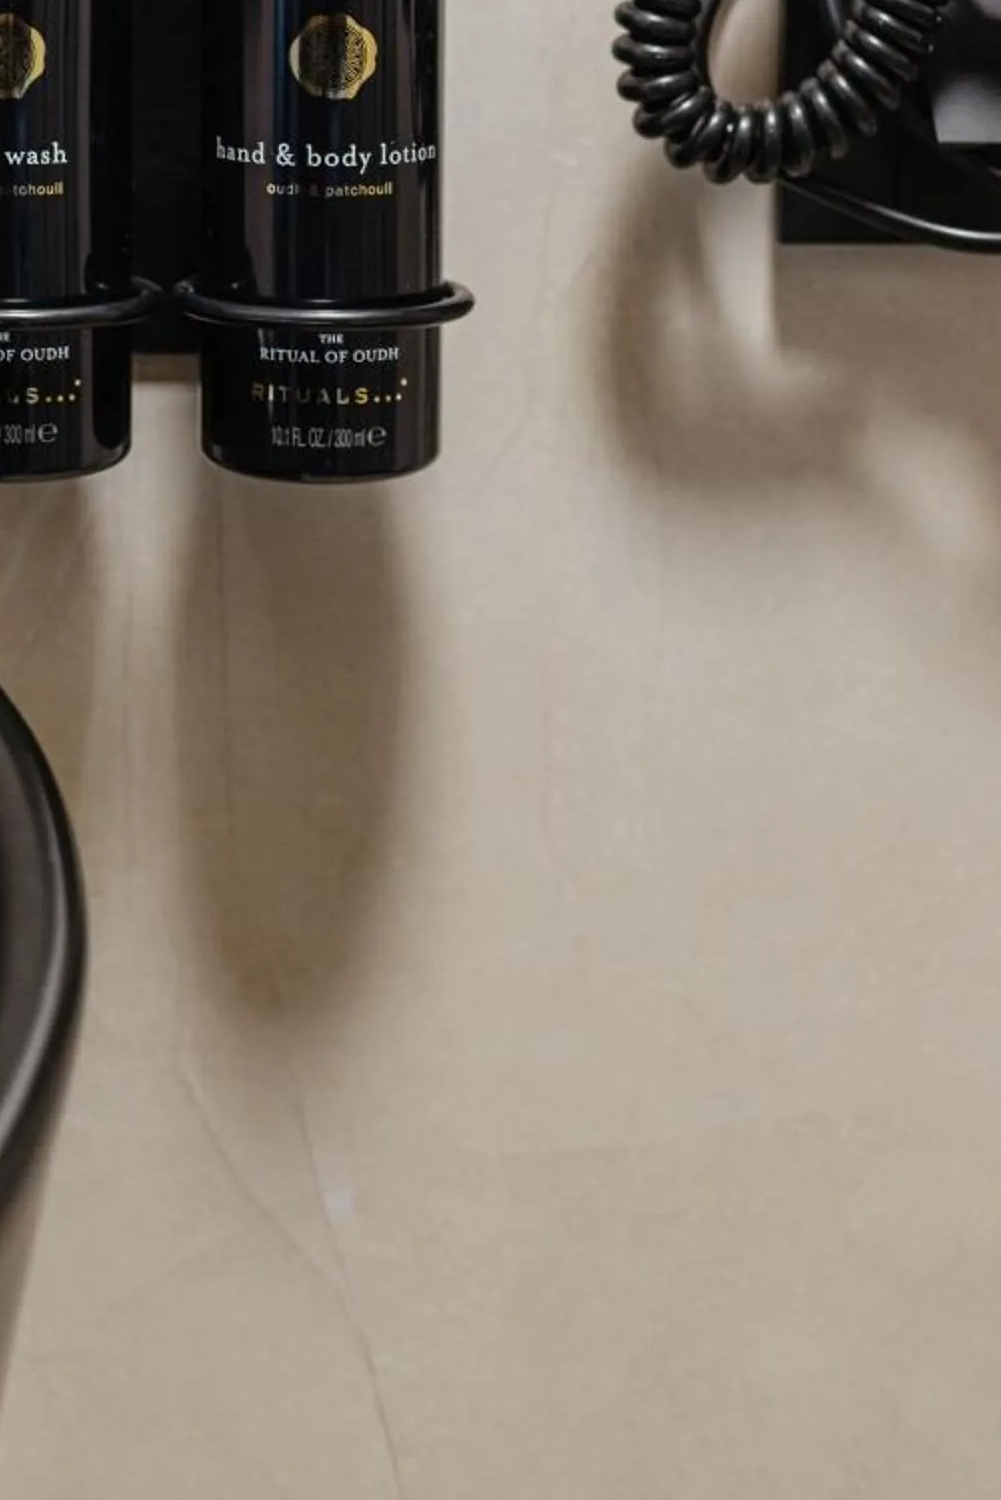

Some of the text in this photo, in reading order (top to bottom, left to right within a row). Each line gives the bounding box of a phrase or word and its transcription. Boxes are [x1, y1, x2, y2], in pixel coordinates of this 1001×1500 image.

[4, 141, 68, 165] wash
[215, 135, 437, 175] hand & body lotion
[325, 181, 393, 199] patchouli
[318, 333, 344, 345] THE
[20, 345, 70, 362] OUDH
[259, 346, 400, 364] RITUAL OF OUDH
